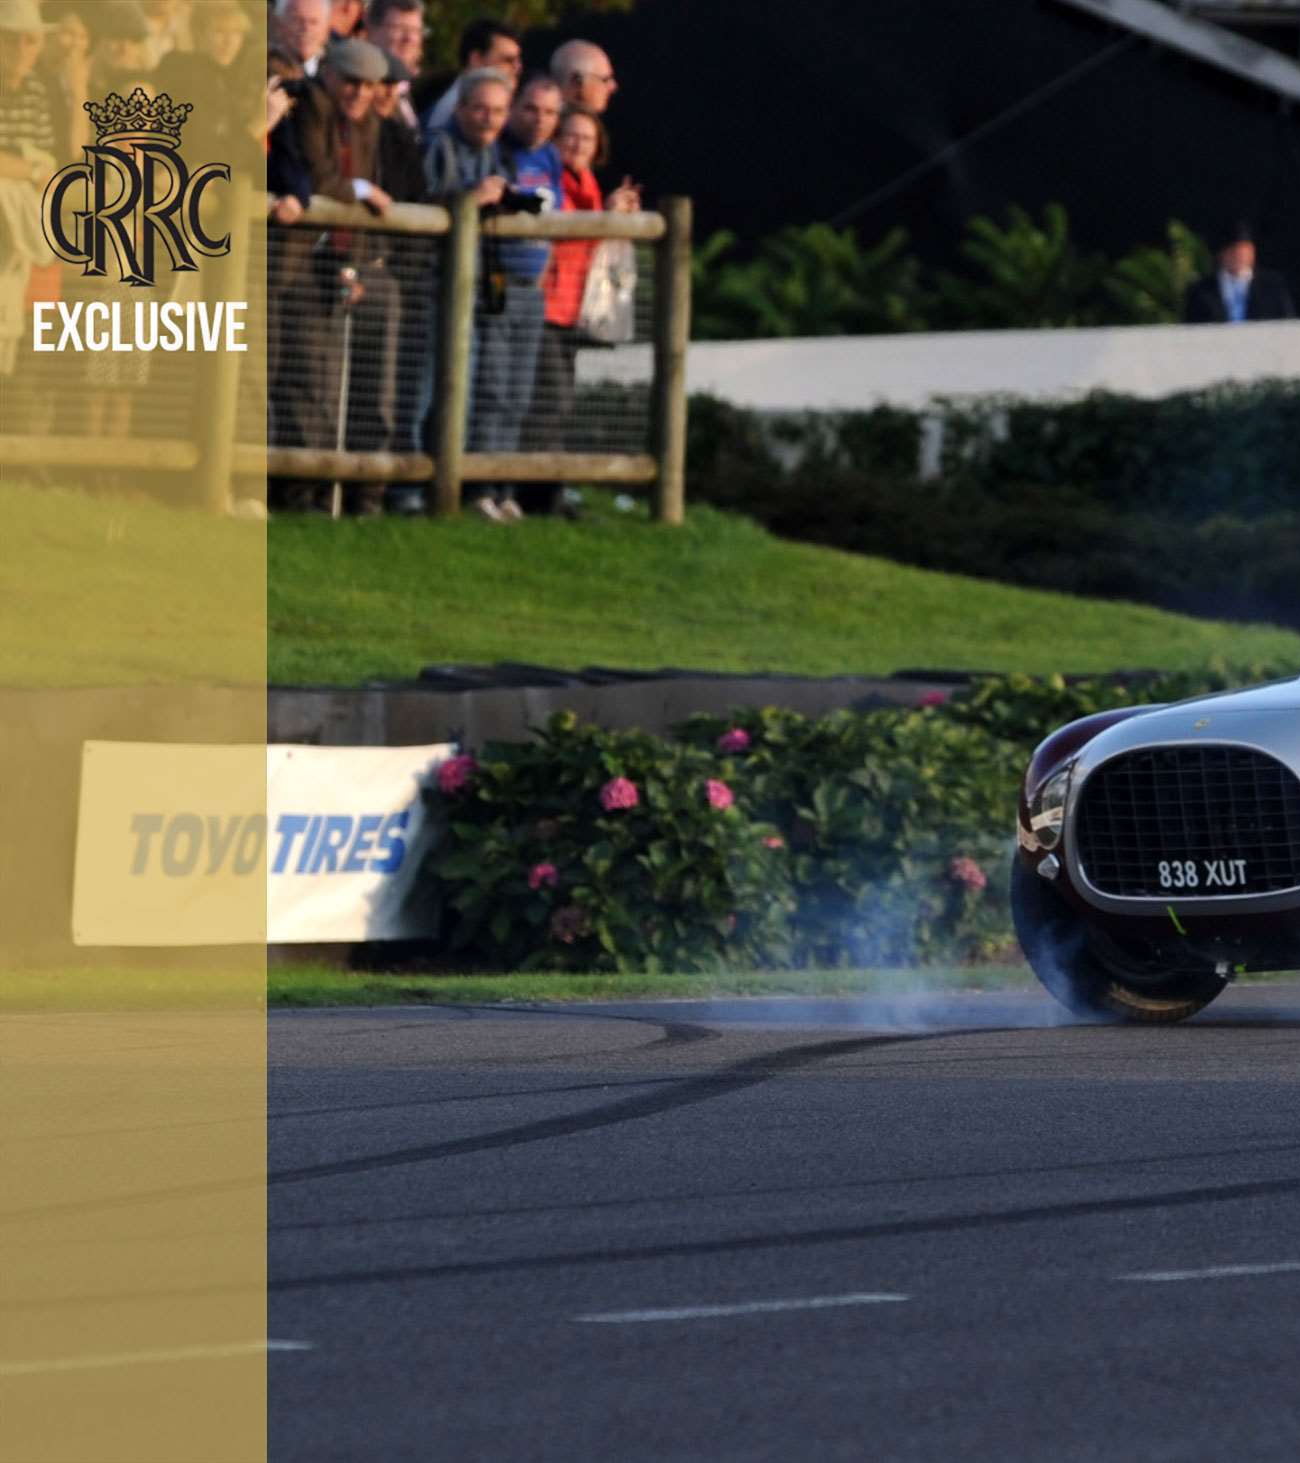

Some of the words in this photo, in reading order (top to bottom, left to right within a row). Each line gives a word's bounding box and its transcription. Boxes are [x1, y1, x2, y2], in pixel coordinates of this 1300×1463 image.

[129, 812, 267, 877] TOYO
[271, 810, 410, 874] TIRES
[1159, 860, 1199, 888] 838
[1203, 859, 1247, 886] XUT
